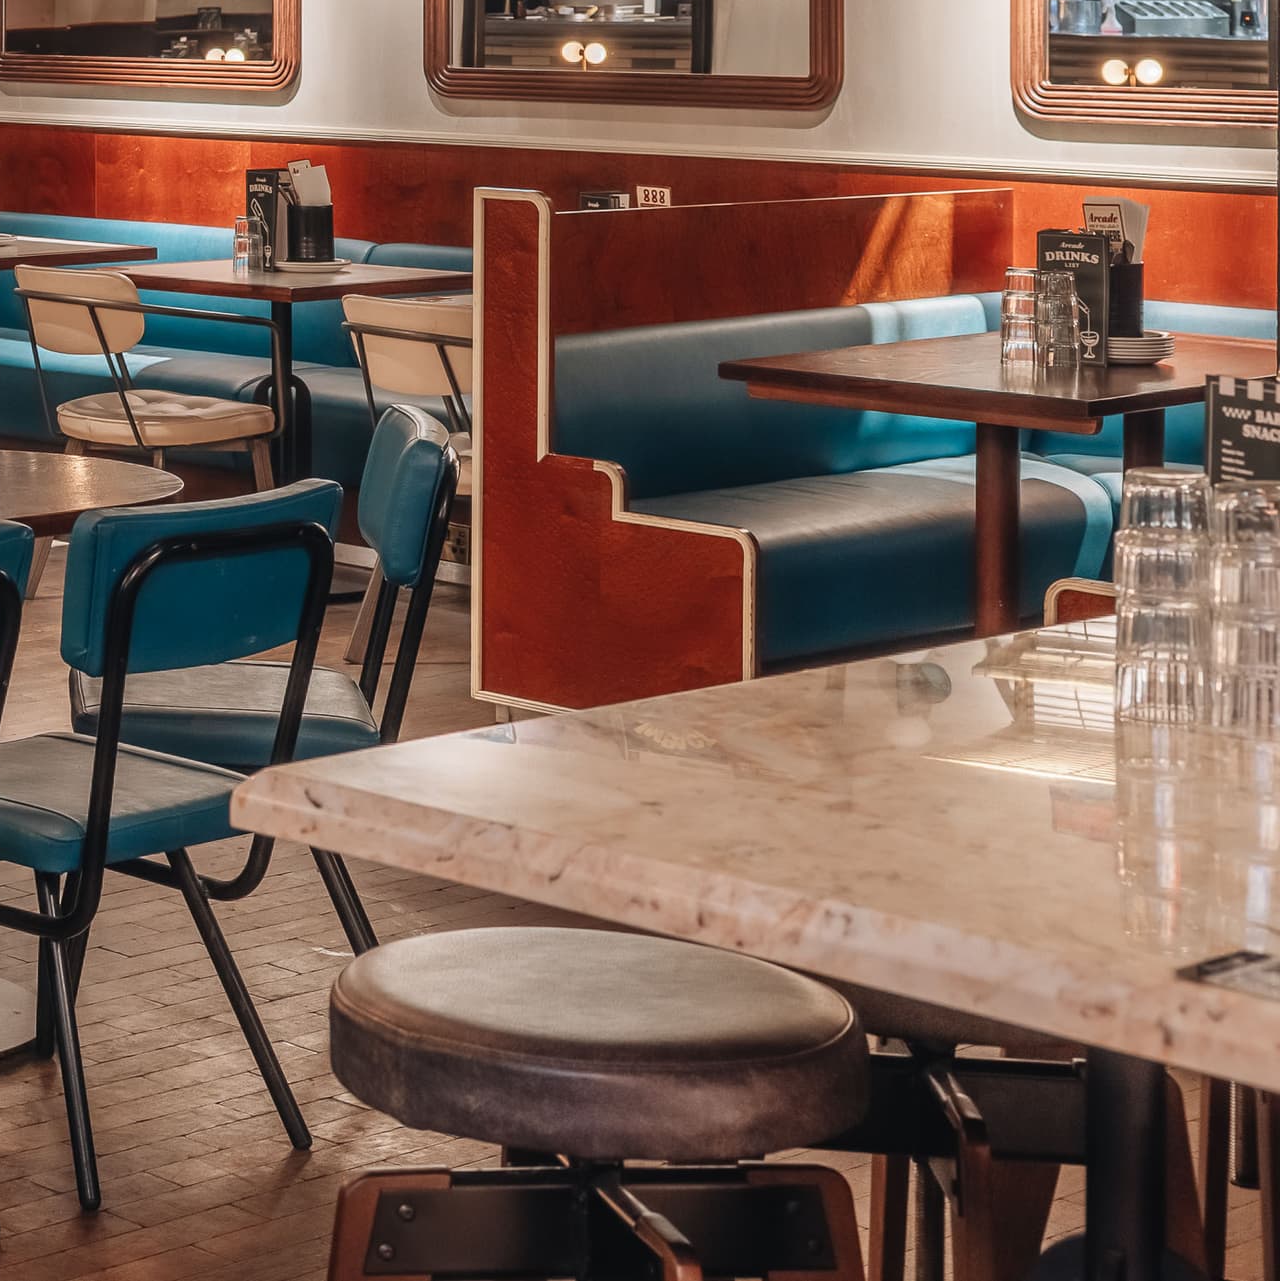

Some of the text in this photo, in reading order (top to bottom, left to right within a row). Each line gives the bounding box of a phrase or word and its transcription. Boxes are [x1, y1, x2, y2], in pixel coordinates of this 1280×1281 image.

[643, 188, 665, 204] 888
[1088, 212, 1119, 224] Arcade
[1044, 251, 1100, 265] DRINKS
